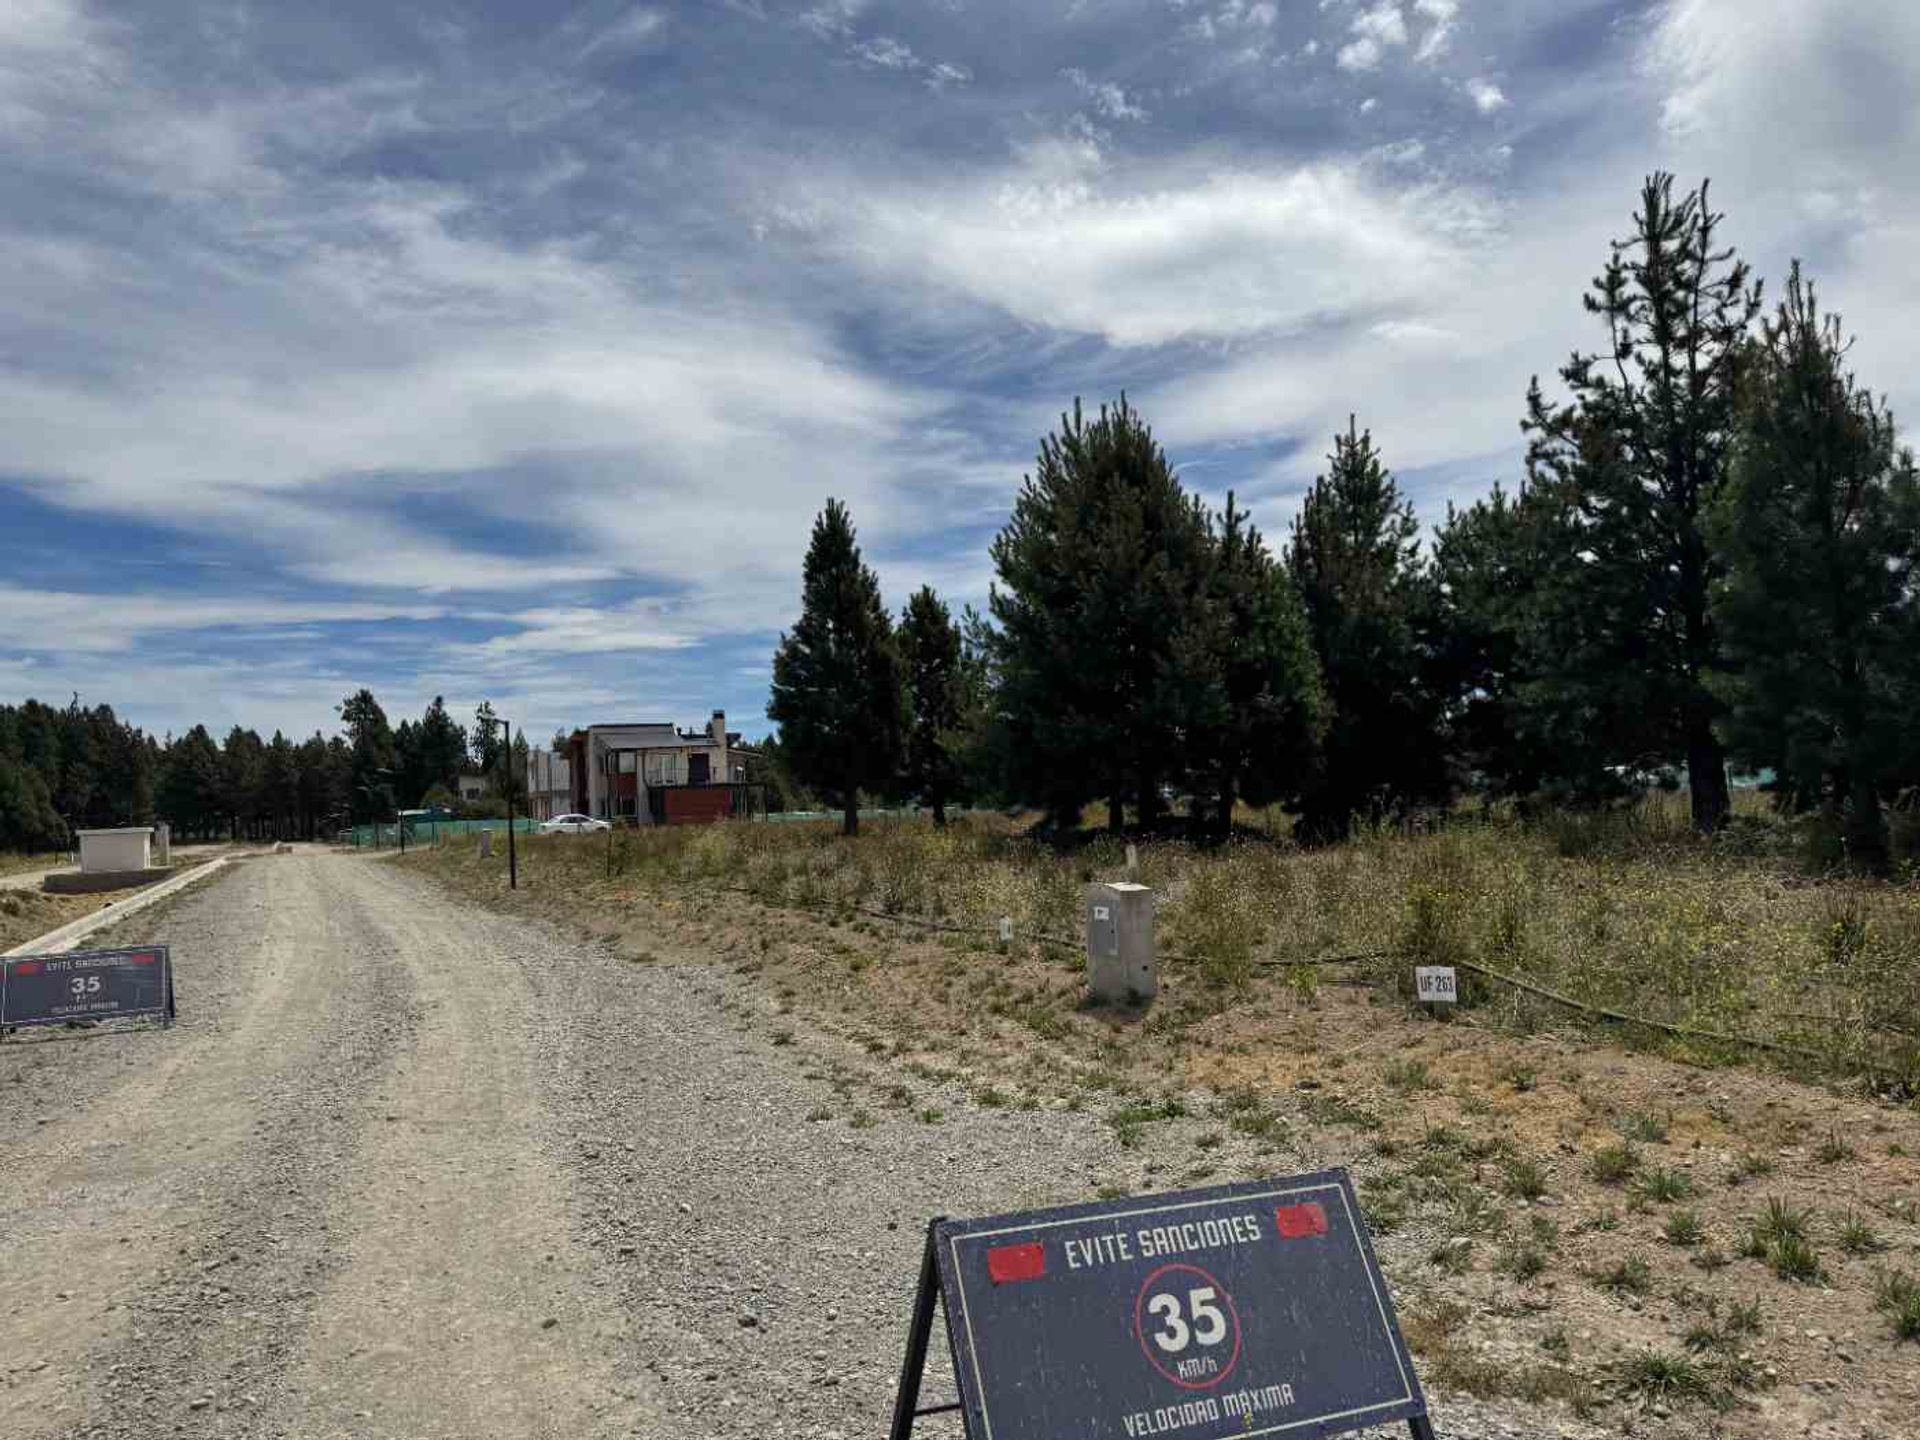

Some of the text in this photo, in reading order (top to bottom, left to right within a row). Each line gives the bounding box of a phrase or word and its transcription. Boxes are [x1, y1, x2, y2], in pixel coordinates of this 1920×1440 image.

[71, 976, 101, 993] 35
[1420, 975, 1433, 992] UF
[1064, 1214, 1262, 1269] EVITE SANCIONES
[1148, 1286, 1227, 1352] 35
[1123, 1397, 1220, 1438] VELOCIDAD
